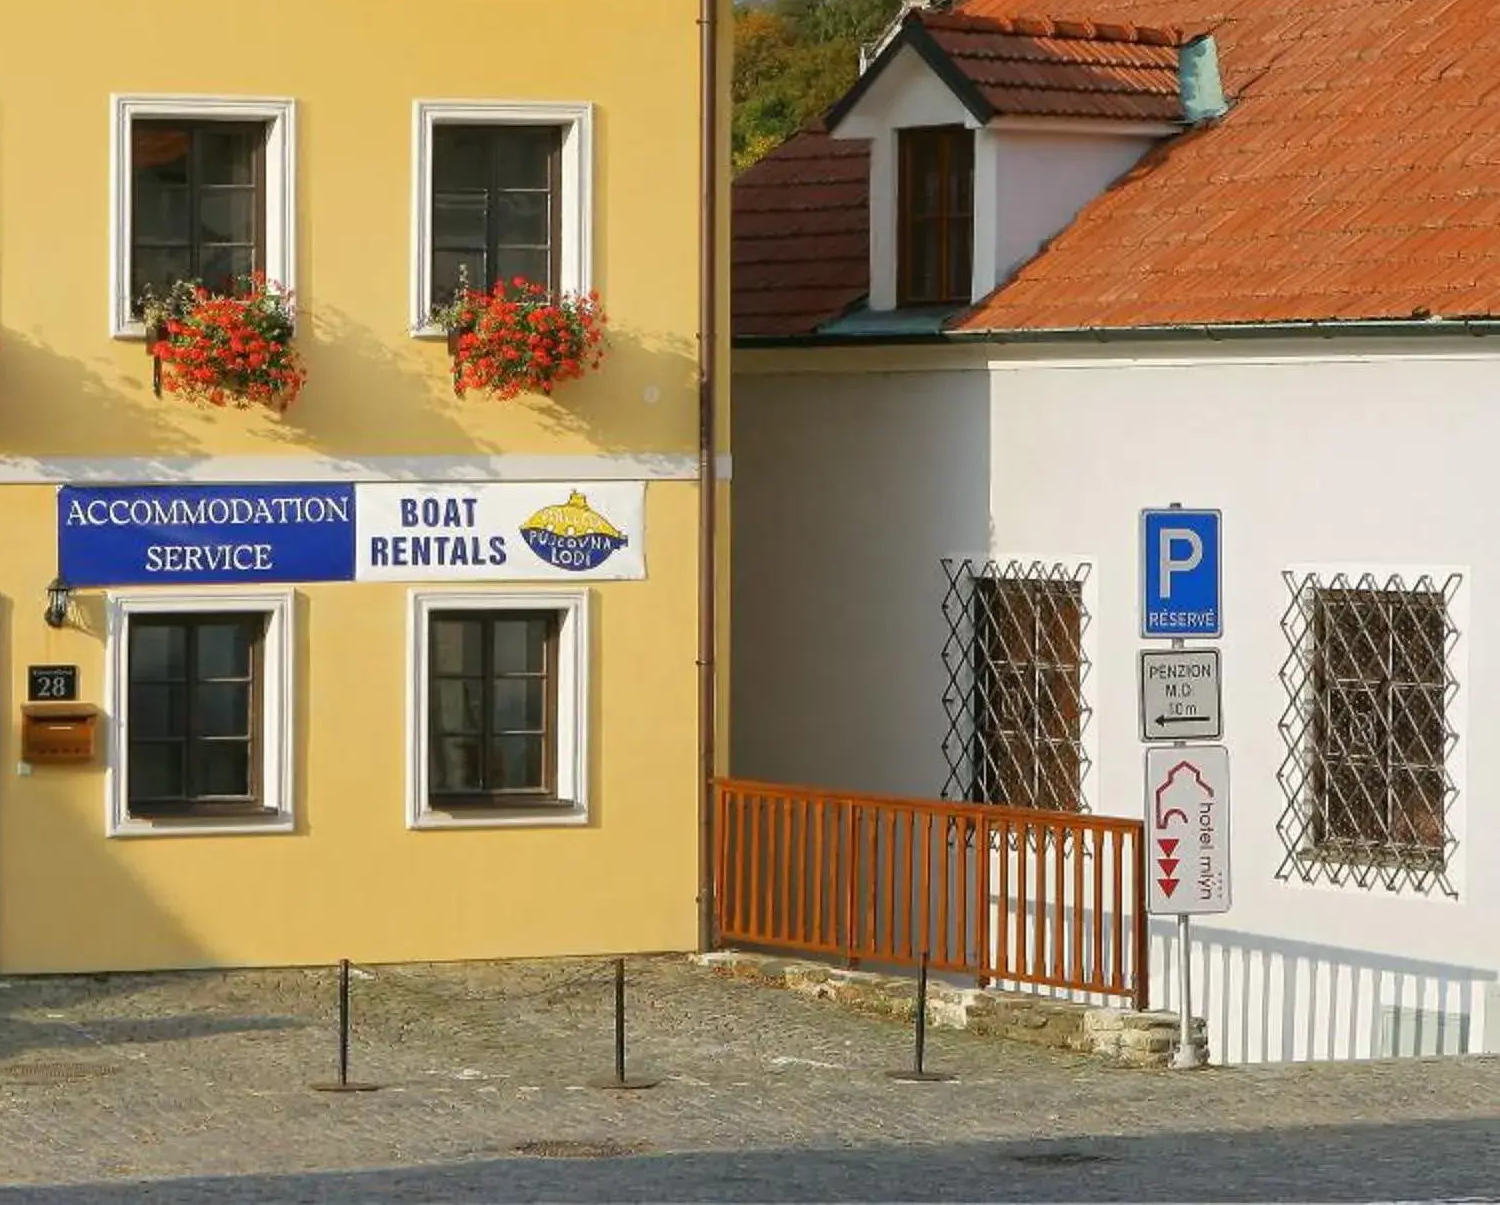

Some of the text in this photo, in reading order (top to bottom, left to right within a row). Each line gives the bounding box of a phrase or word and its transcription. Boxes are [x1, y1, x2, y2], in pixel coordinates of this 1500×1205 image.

[66, 496, 349, 526] ACCOMMODATION
[400, 497, 478, 528] BOAT
[145, 544, 273, 571] SERVICE
[371, 536, 507, 566] RENTALS
[1160, 528, 1203, 599] P
[1149, 663, 1211, 679] PENZION
[37, 676, 66, 697] 28
[1200, 802, 1215, 850] hotel
